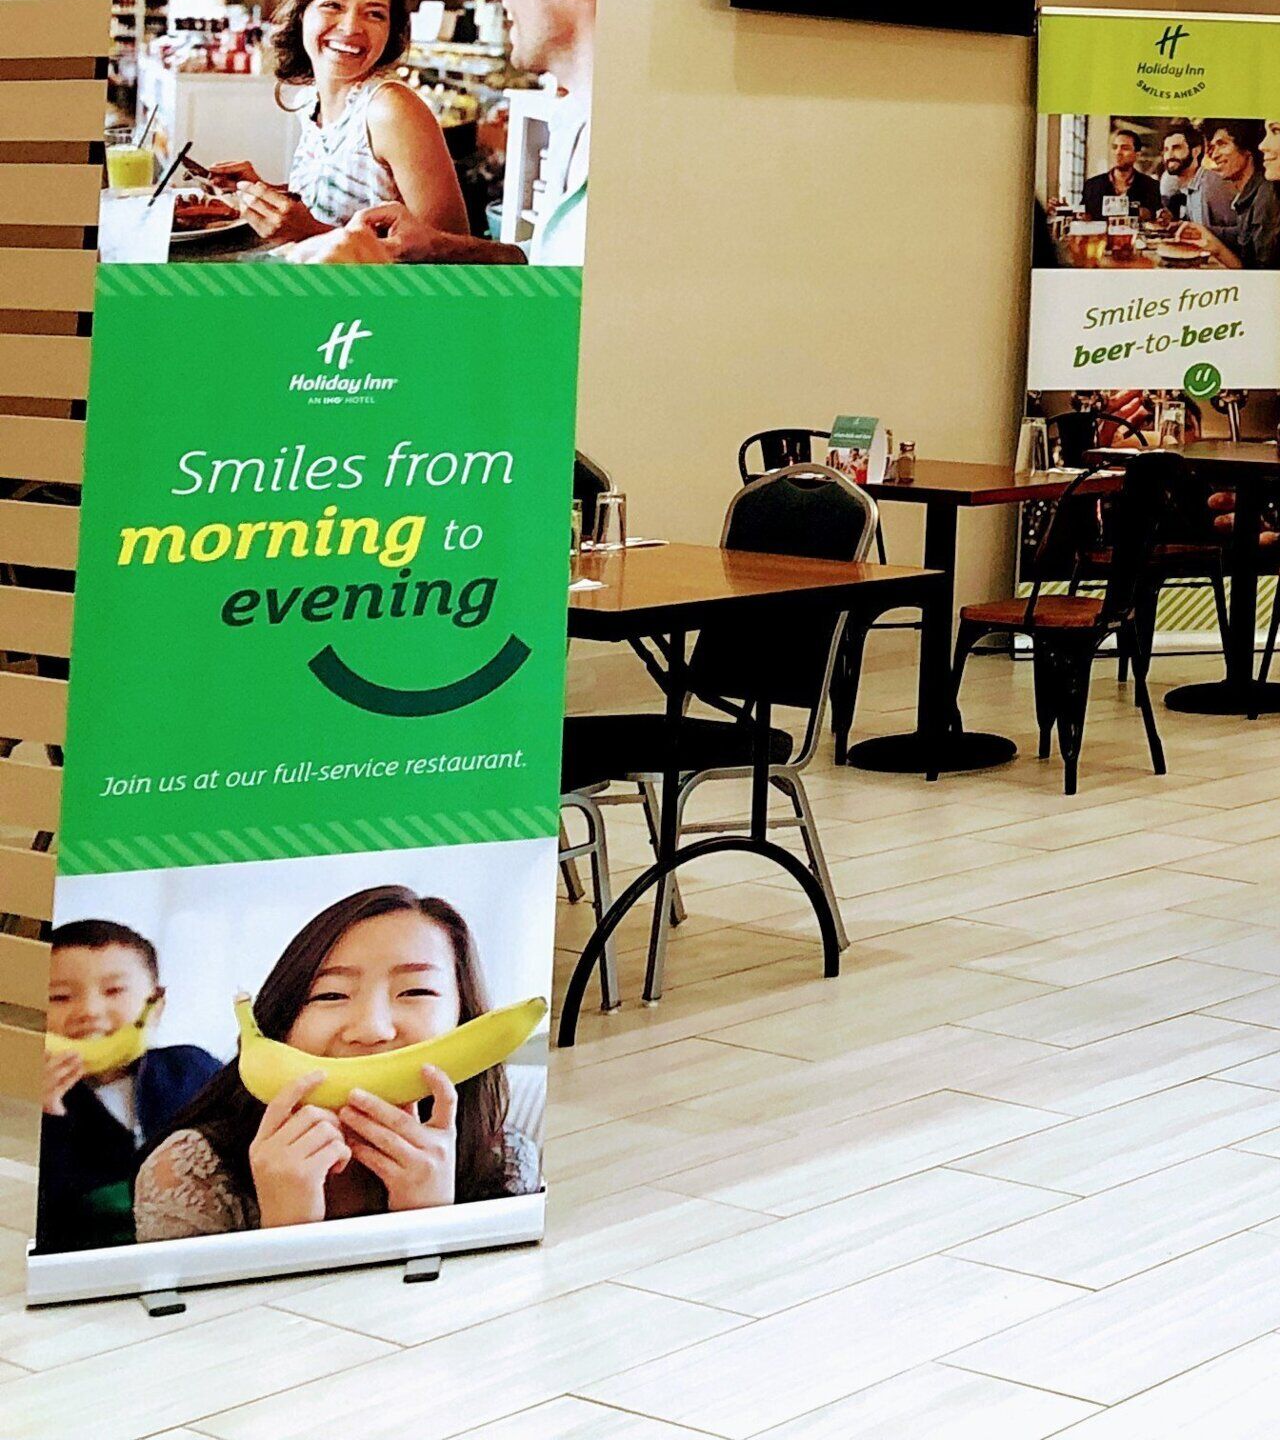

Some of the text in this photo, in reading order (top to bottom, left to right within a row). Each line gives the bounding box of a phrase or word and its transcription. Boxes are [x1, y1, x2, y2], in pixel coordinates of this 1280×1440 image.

[1136, 62, 1206, 78] Holiday Inn
[1136, 79, 1206, 99] SMILES AHEAD
[1083, 285, 1240, 330] Smiles from
[1073, 320, 1246, 368] beer-to-beer.
[289, 372, 394, 394] Holiday Inn
[308, 397, 321, 405] AN
[344, 396, 375, 405] HOTEL
[170, 440, 515, 497] Smiles from
[116, 504, 483, 568] morning to
[220, 568, 500, 629] evening
[98, 748, 528, 797] Join us at our full-service restaurant.
